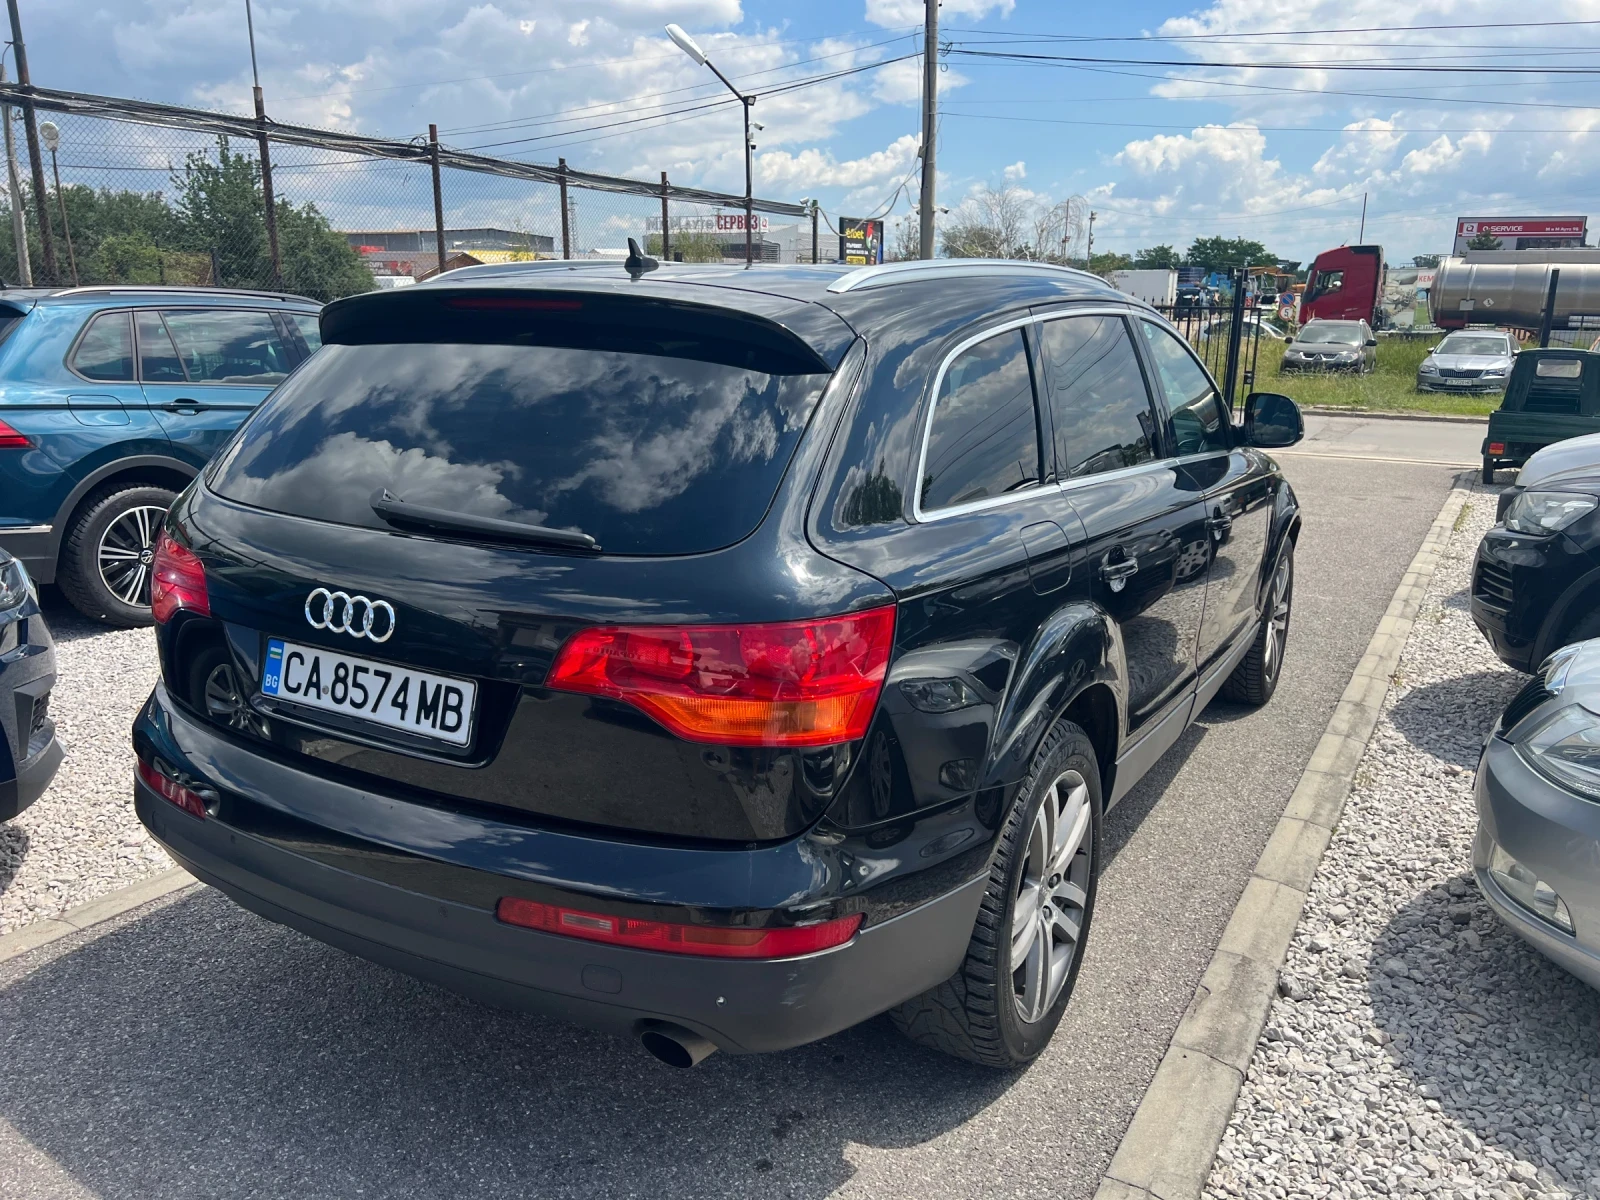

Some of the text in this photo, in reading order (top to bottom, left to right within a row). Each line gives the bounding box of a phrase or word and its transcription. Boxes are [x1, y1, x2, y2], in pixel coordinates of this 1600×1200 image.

[1284, 308, 1289, 316] 5
[264, 673, 279, 689] BG
[283, 651, 464, 733] CA 8574 MB
